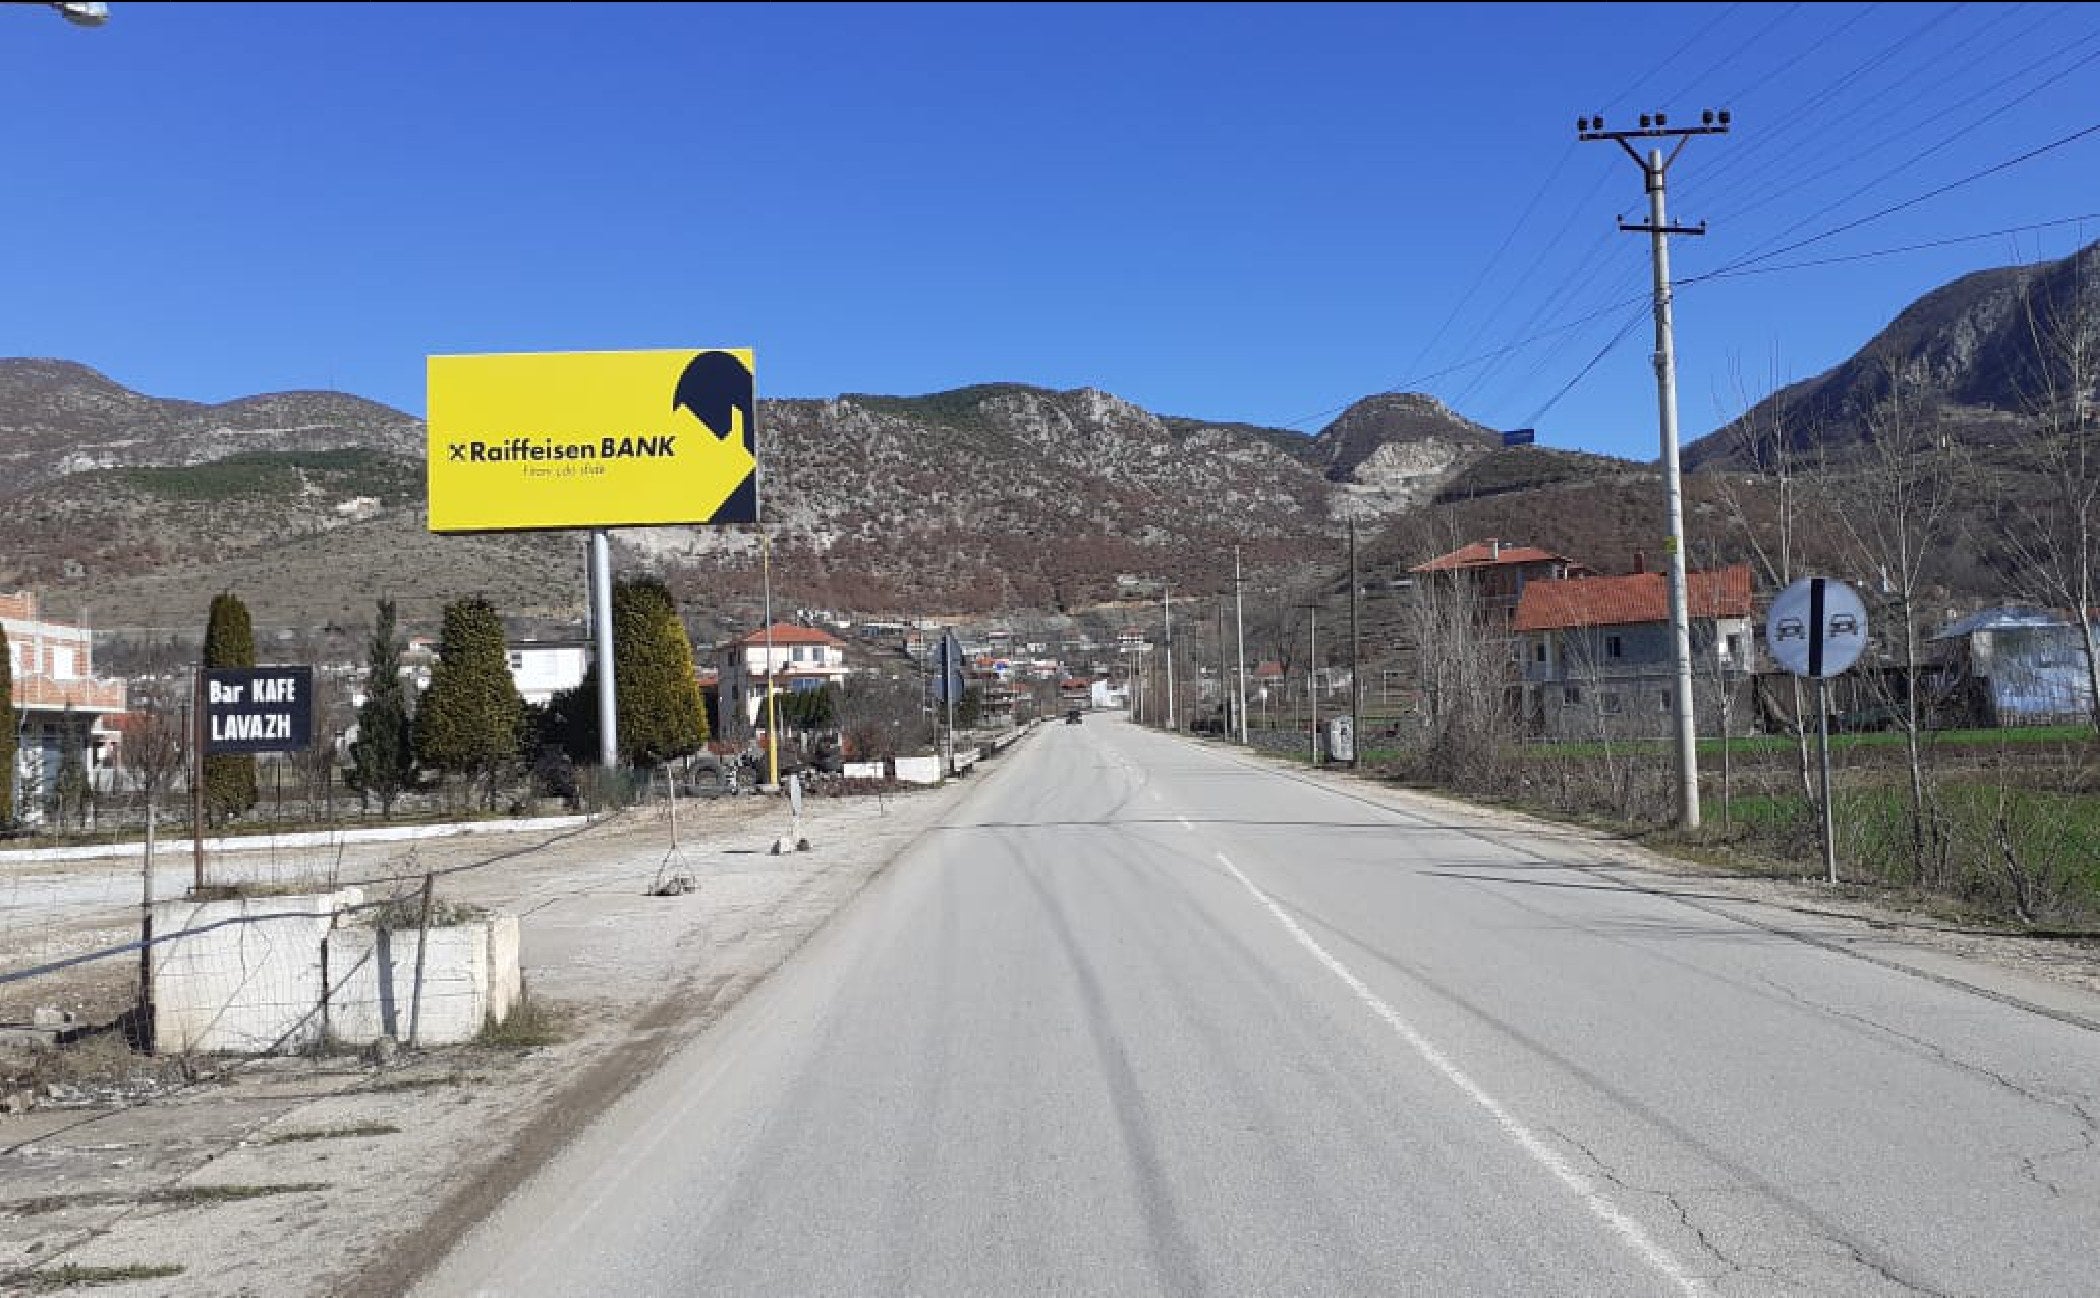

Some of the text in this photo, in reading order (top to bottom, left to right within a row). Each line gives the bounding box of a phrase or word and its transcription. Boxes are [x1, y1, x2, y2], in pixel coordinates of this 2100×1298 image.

[470, 436, 676, 461] Raiffeisen BANK
[210, 678, 295, 704] Bar KAFE
[211, 714, 291, 741] LAVAZH
